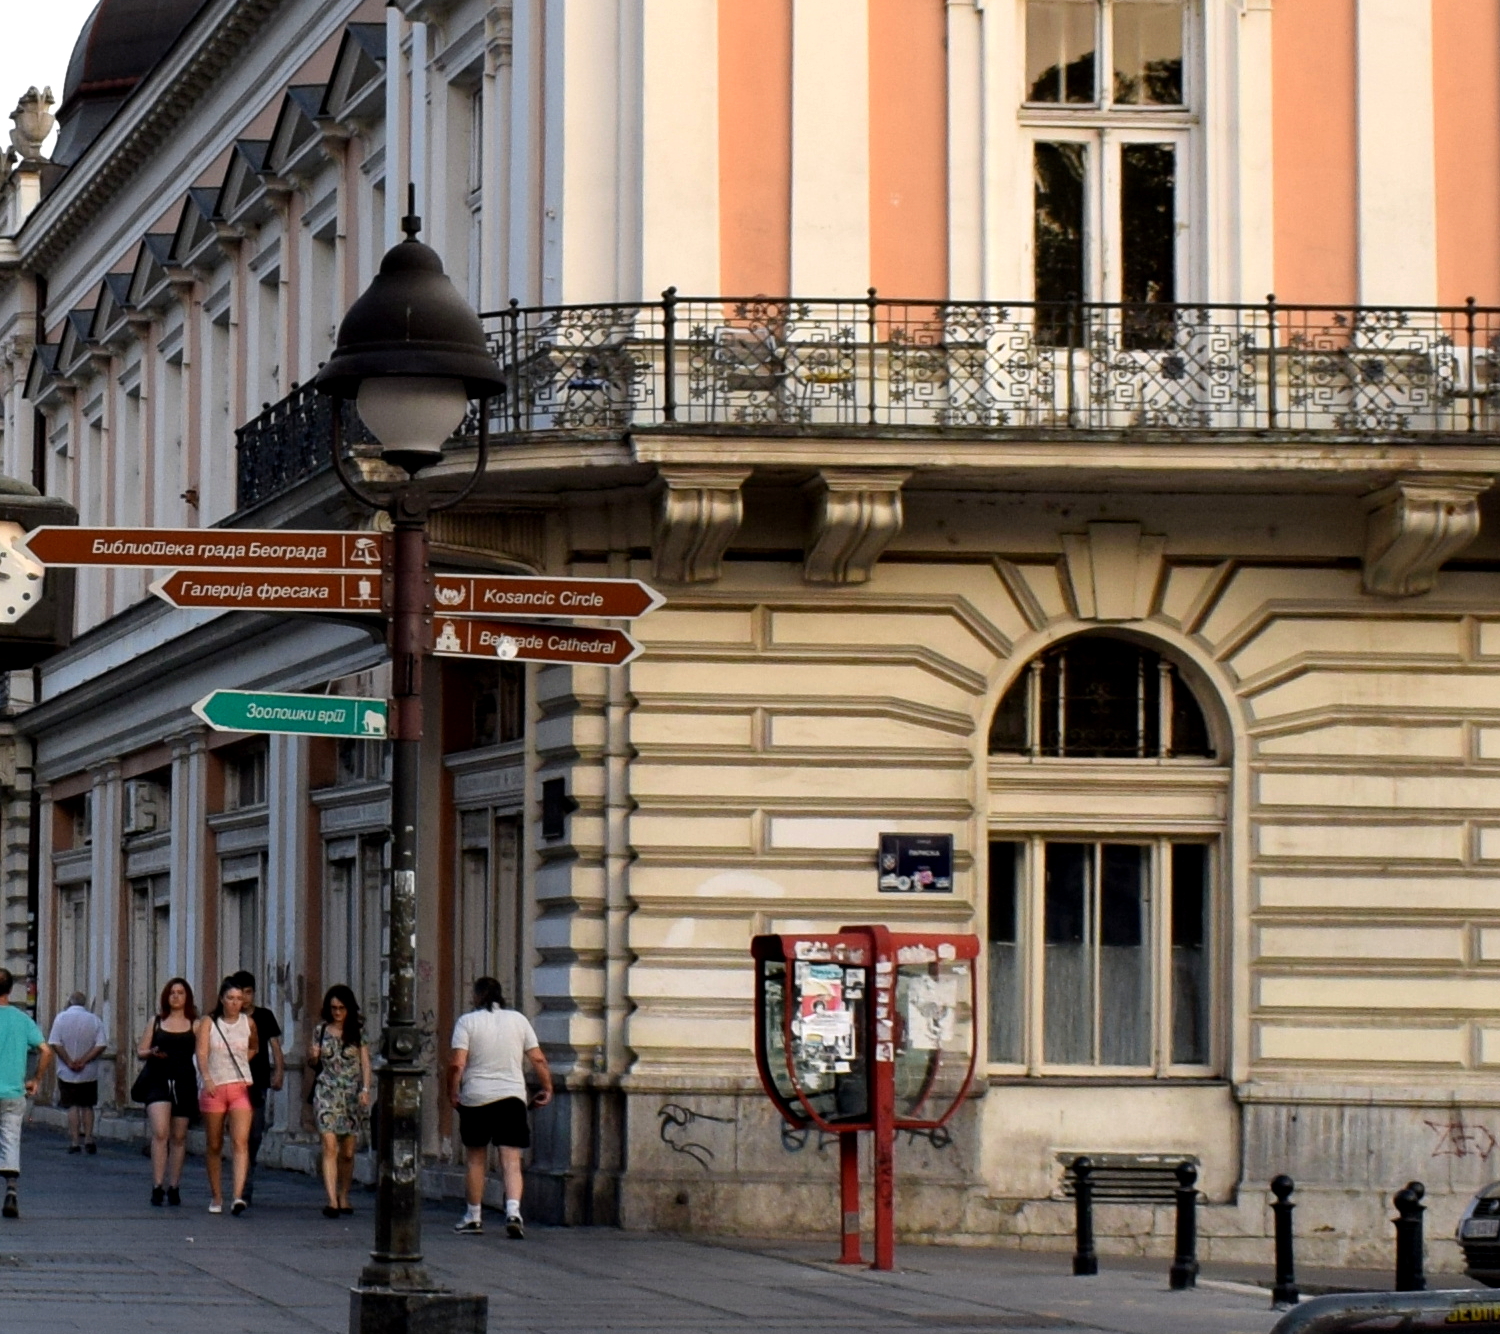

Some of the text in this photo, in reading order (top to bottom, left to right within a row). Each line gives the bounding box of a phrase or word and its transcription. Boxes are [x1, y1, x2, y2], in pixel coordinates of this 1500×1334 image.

[92, 538, 327, 560] Библиотека града Београда
[180, 581, 329, 601] Галерија фресака
[483, 588, 604, 607] Kosancic Circle
[547, 635, 617, 654] Cathedral
[246, 702, 346, 724] Зоолошки врт
